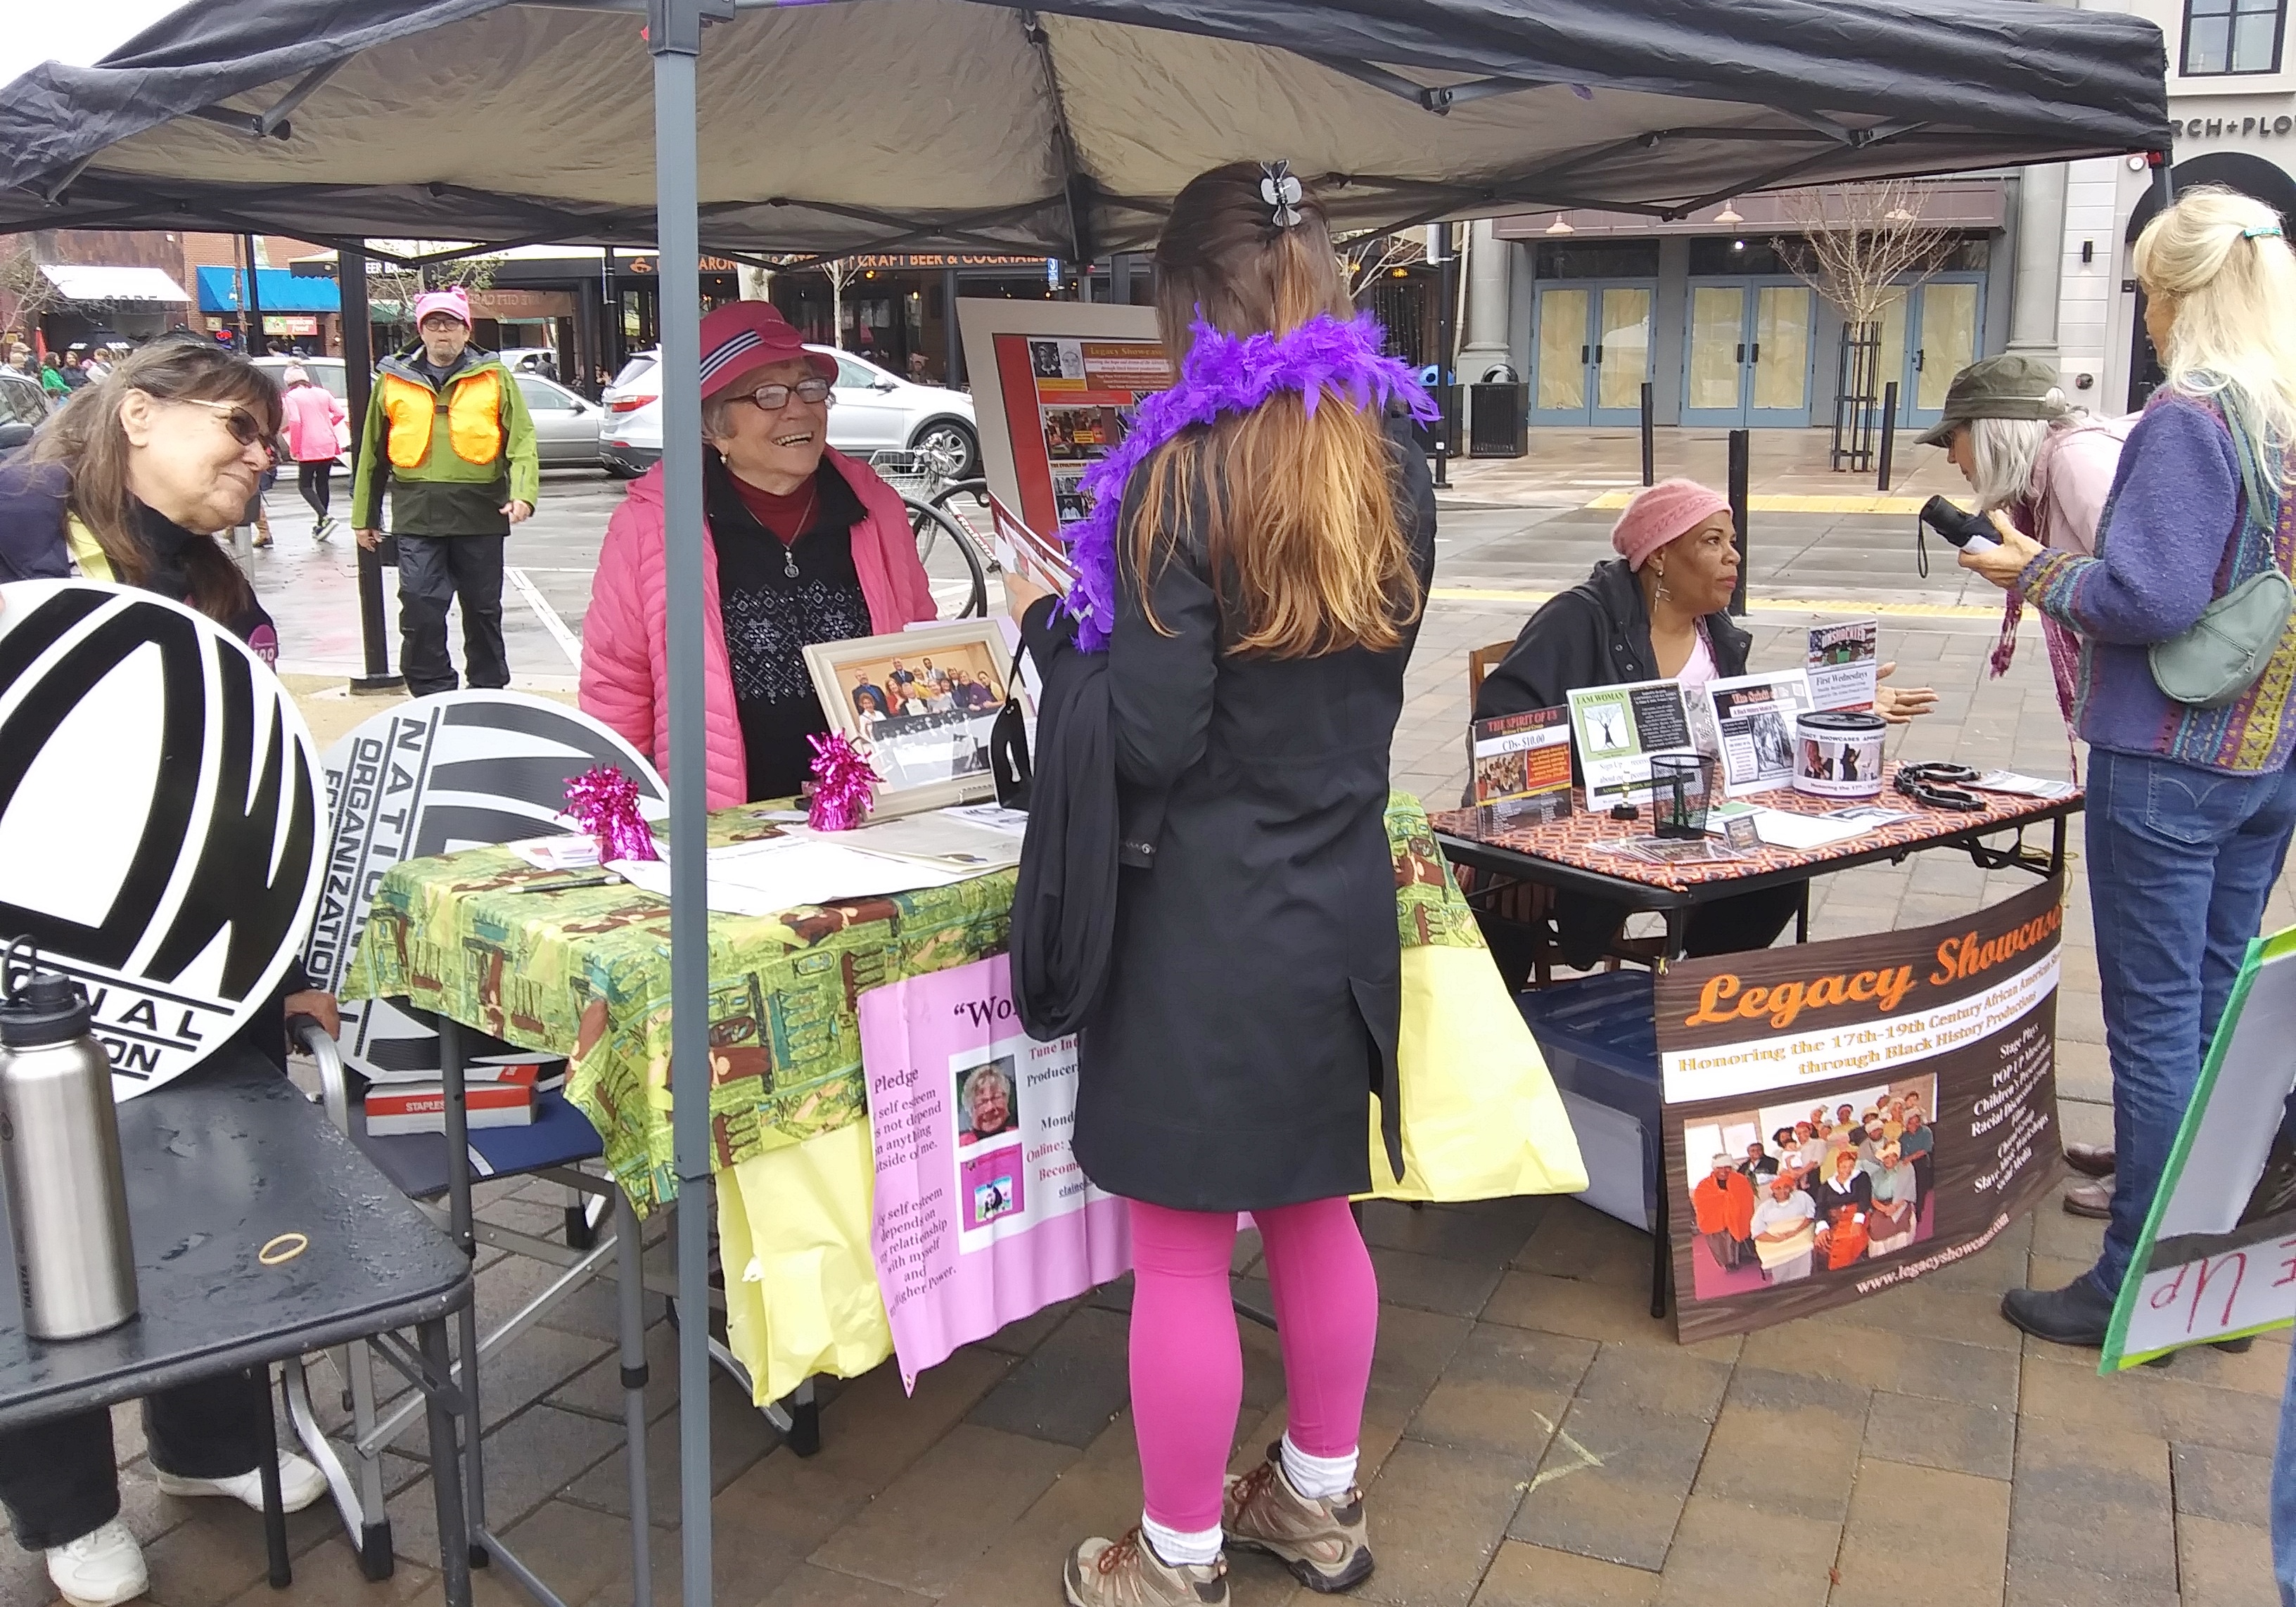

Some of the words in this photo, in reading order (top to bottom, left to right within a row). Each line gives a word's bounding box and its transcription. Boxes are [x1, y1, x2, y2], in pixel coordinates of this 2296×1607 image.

[910, 255, 944, 265] BEER
[1816, 675, 1831, 686] First
[1832, 671, 1868, 684] Wednesdays
[1581, 693, 1595, 704] AM
[1595, 691, 1625, 703] WOMAN
[1748, 688, 1770, 703] Spirit
[1488, 719, 1505, 732] THE
[1507, 714, 1534, 730] SPIRIT
[1534, 712, 1546, 724] OF
[1522, 734, 1545, 748] $10.00
[1599, 762, 1613, 772] Sign
[1614, 760, 1623, 770] Up
[1600, 774, 1615, 784] about
[1685, 964, 1918, 1029] Legacy
[1678, 1043, 1786, 1073] Honoring
[1790, 1039, 1825, 1056] the
[1831, 1020, 1925, 1049] 17th-19th
[1929, 1001, 1983, 1029] Century
[1984, 984, 2018, 1010] African
[2020, 961, 2051, 992] American
[1798, 1051, 1878, 1076] through
[1884, 1037, 1933, 1060] Black
[1936, 1020, 1984, 1047] History
[1986, 991, 2037, 1028] Productions
[1999, 1037, 2022, 1060] Stage
[2022, 1021, 2040, 1044] Plays
[1029, 1043, 1057, 1061] Tune
[874, 1068, 919, 1094] Pledge
[1992, 1063, 2013, 1088] POP
[405, 1100, 445, 1113] STAPLES
[879, 1099, 899, 1119] self
[902, 1089, 936, 1111] esteem
[883, 1118, 903, 1134] not
[906, 1101, 942, 1127] depend
[1971, 1107, 2003, 1138] Racial
[886, 1125, 932, 1150] anything
[920, 1140, 938, 1155] me.
[1026, 1140, 1064, 1163] Online:
[1974, 1167, 2001, 1193] Slave
[888, 1201, 910, 1220] self
[912, 1187, 943, 1211] esteem
[881, 1215, 924, 1243] depends
[924, 1208, 936, 1222] on
[888, 1219, 948, 1255] relationship
[903, 1265, 926, 1283] and
